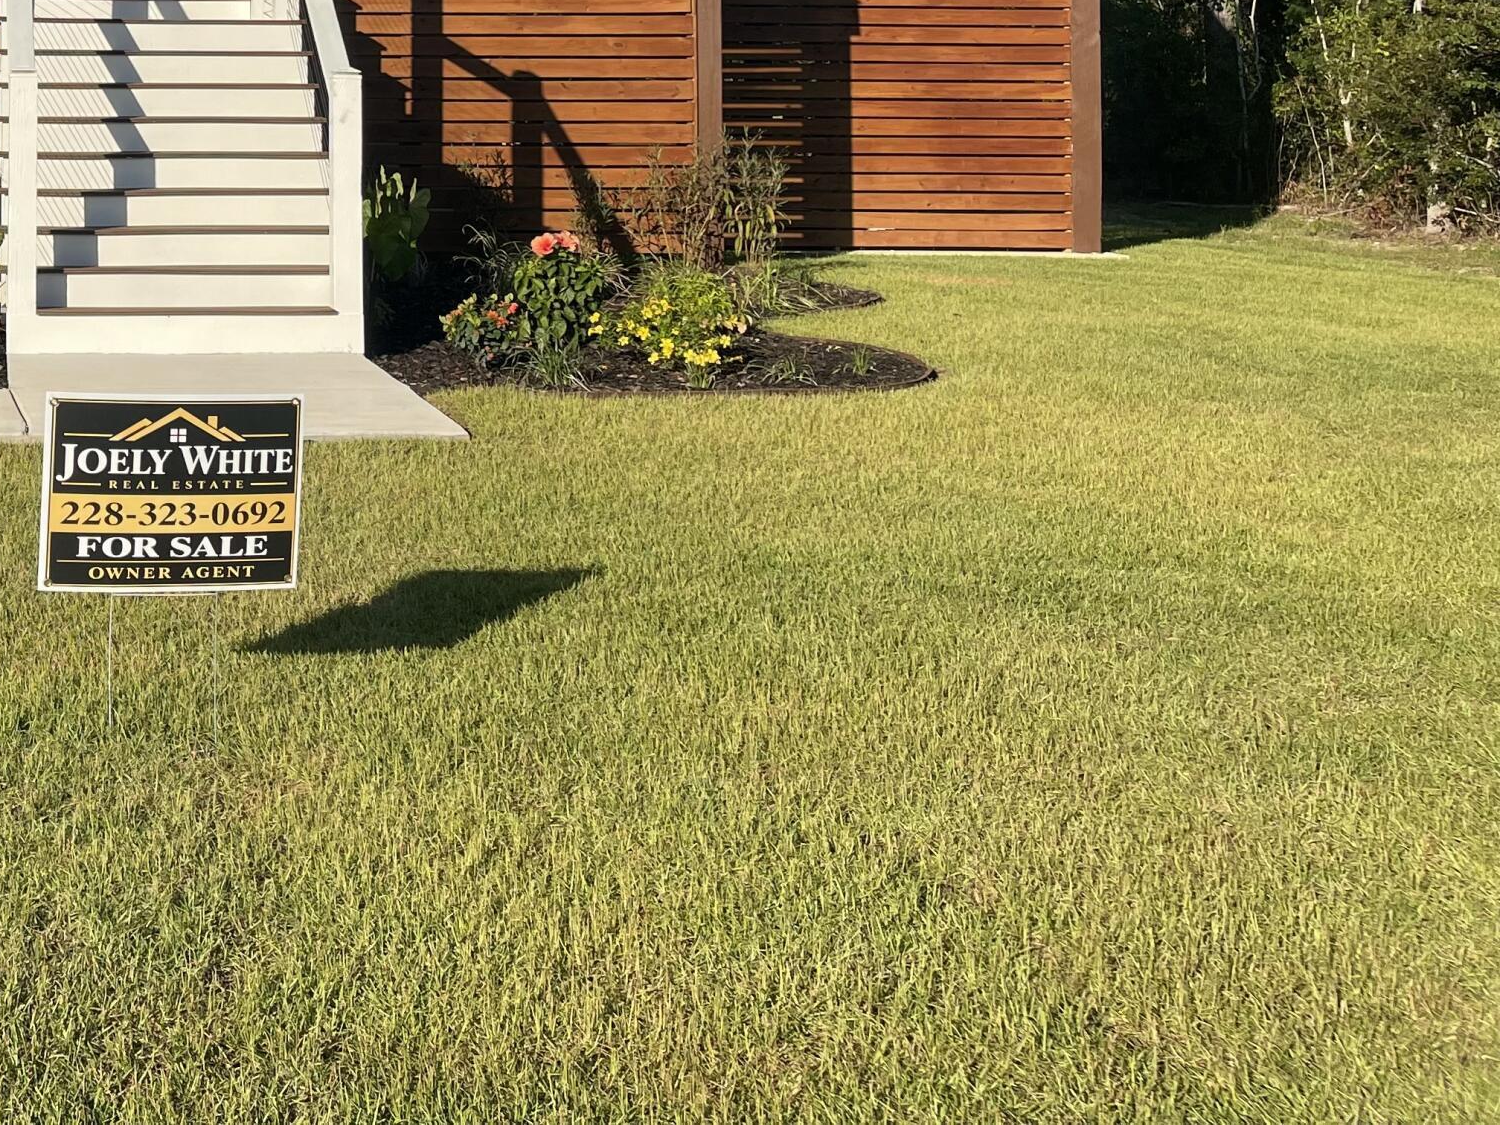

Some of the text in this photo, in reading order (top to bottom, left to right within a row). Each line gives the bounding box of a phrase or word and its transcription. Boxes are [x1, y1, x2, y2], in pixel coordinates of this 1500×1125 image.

[55, 443, 293, 482] JOELY WHITE
[109, 479, 244, 490] REAL ESTATE
[60, 500, 286, 526] 228-323-0692
[76, 535, 268, 559] FOR SALE
[88, 565, 255, 580] OWNER AGENT
